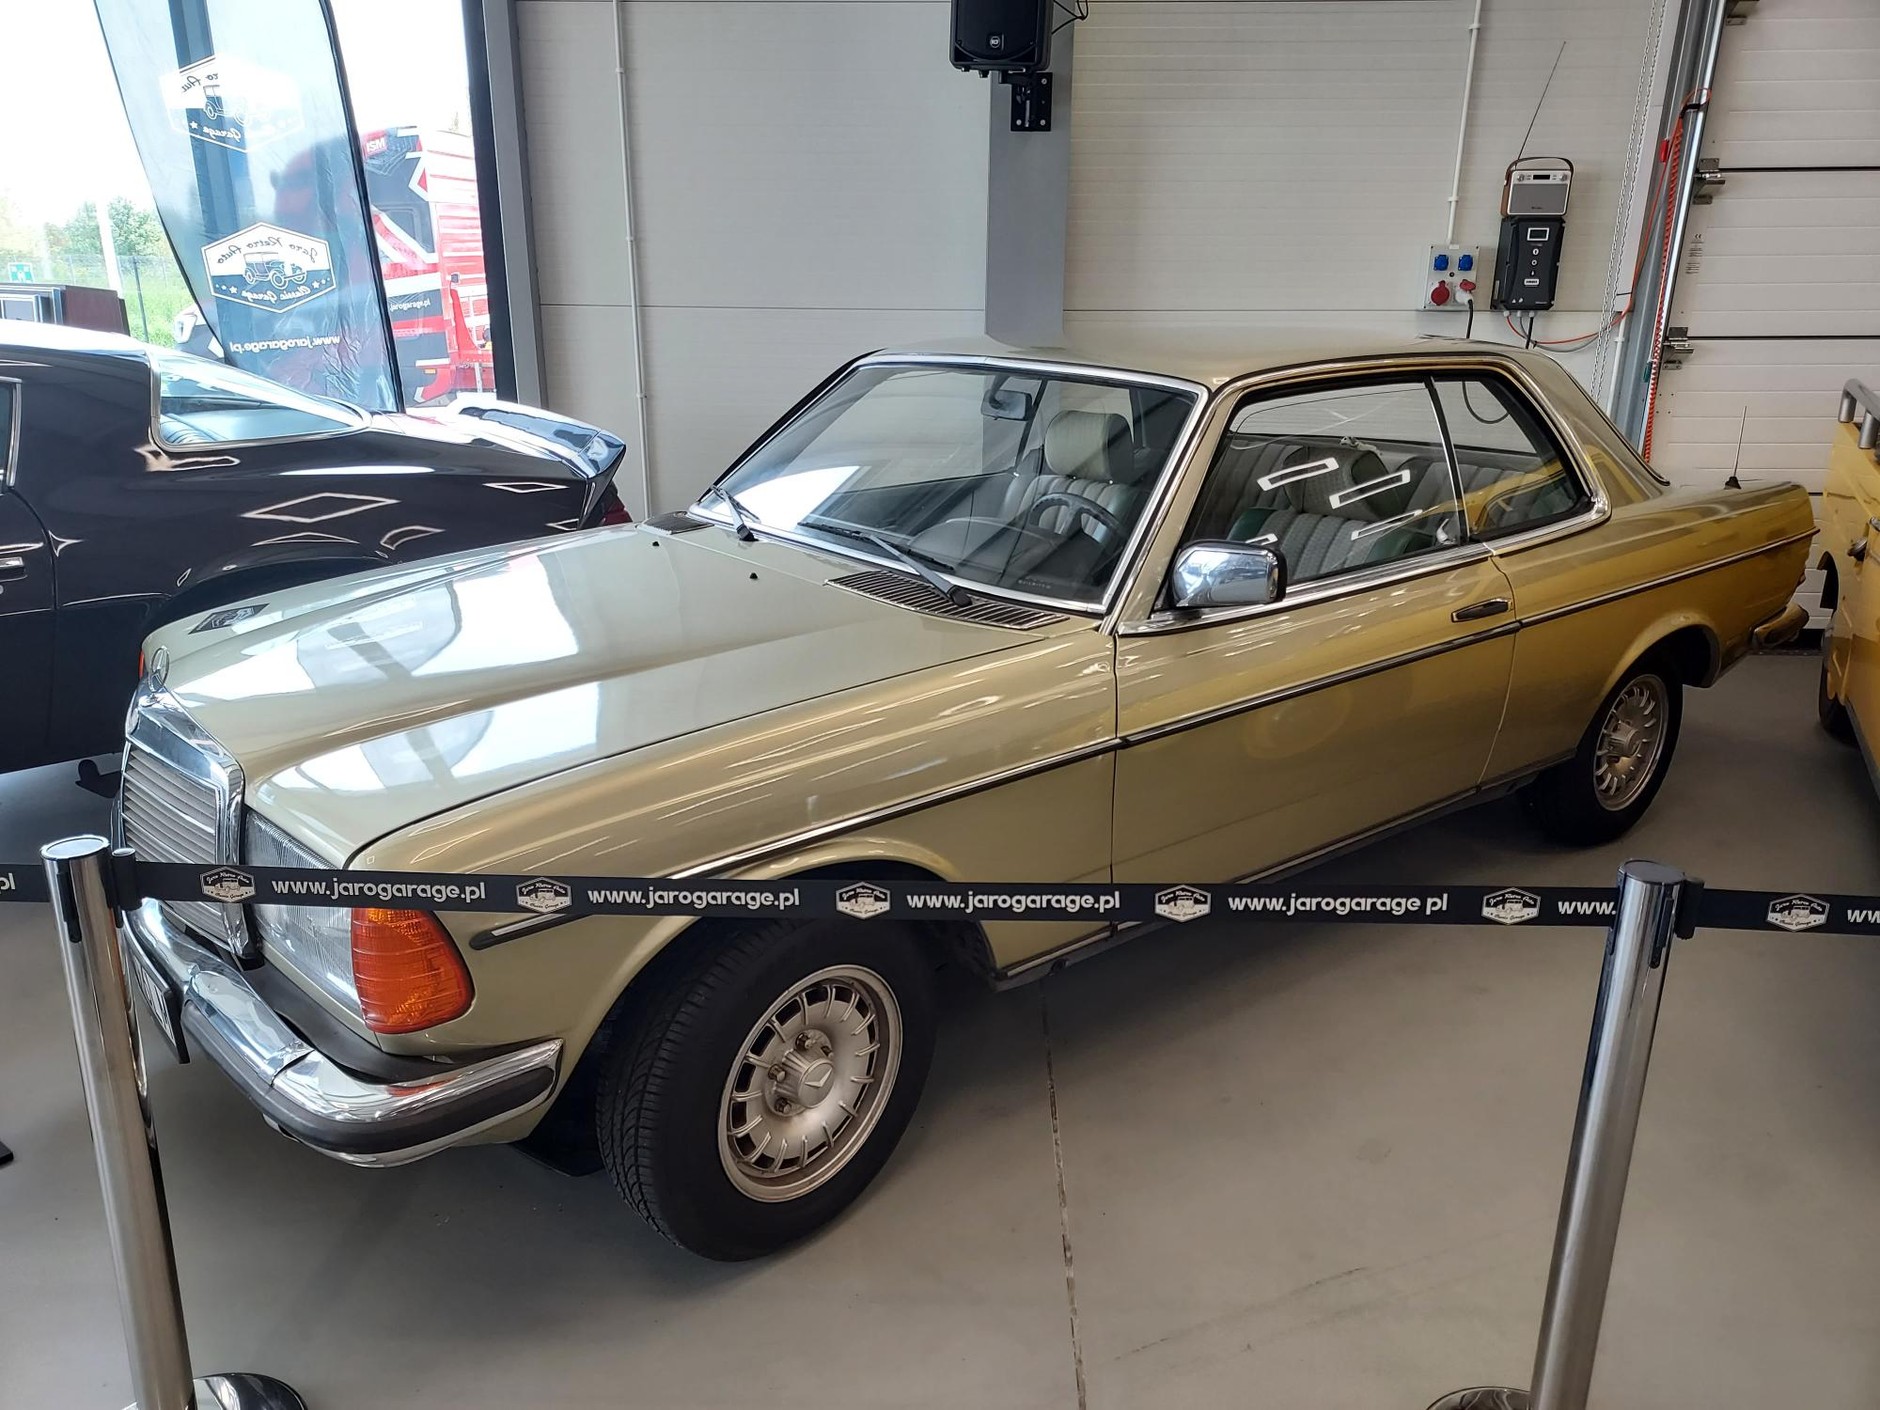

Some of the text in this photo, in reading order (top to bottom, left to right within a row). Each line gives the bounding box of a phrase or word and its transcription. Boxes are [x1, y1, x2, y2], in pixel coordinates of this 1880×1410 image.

[271, 877, 486, 904] www.jarogarage.pl
[588, 887, 800, 910] www.jarogarage.pl
[906, 891, 1120, 914] www.jarogarage.pl
